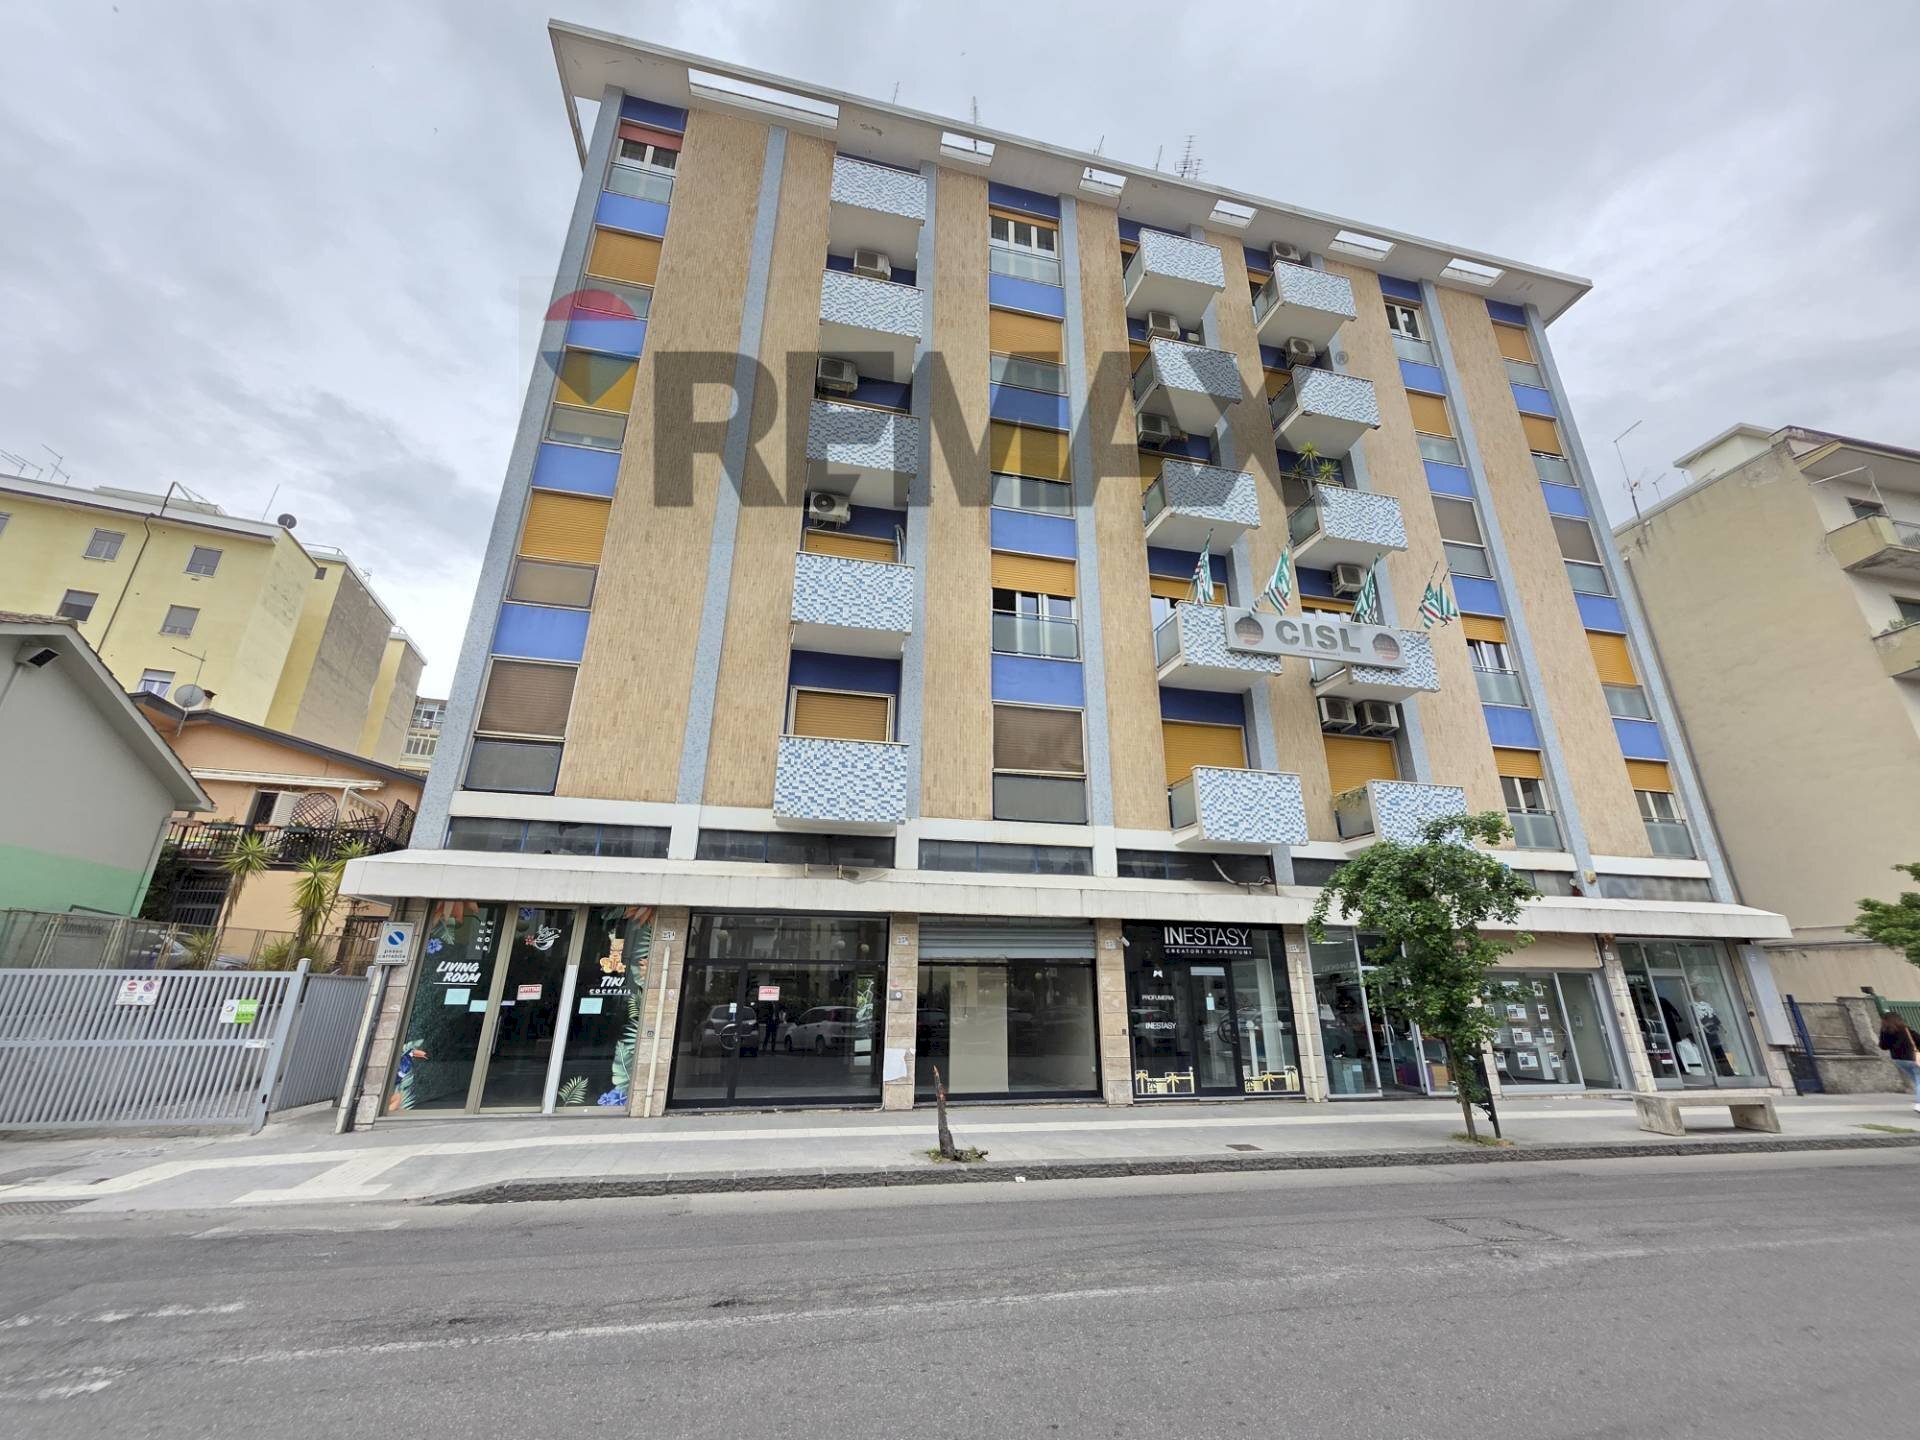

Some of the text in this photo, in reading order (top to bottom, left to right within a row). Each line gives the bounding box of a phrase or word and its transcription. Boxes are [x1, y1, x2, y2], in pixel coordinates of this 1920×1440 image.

[1275, 620, 1360, 653] CISL
[1164, 926, 1250, 946] INESTASY
[436, 960, 480, 973] LIVING
[442, 972, 482, 983] ROOM
[600, 975, 626, 988] TIKI
[1145, 1021, 1177, 1030] INESTASY
